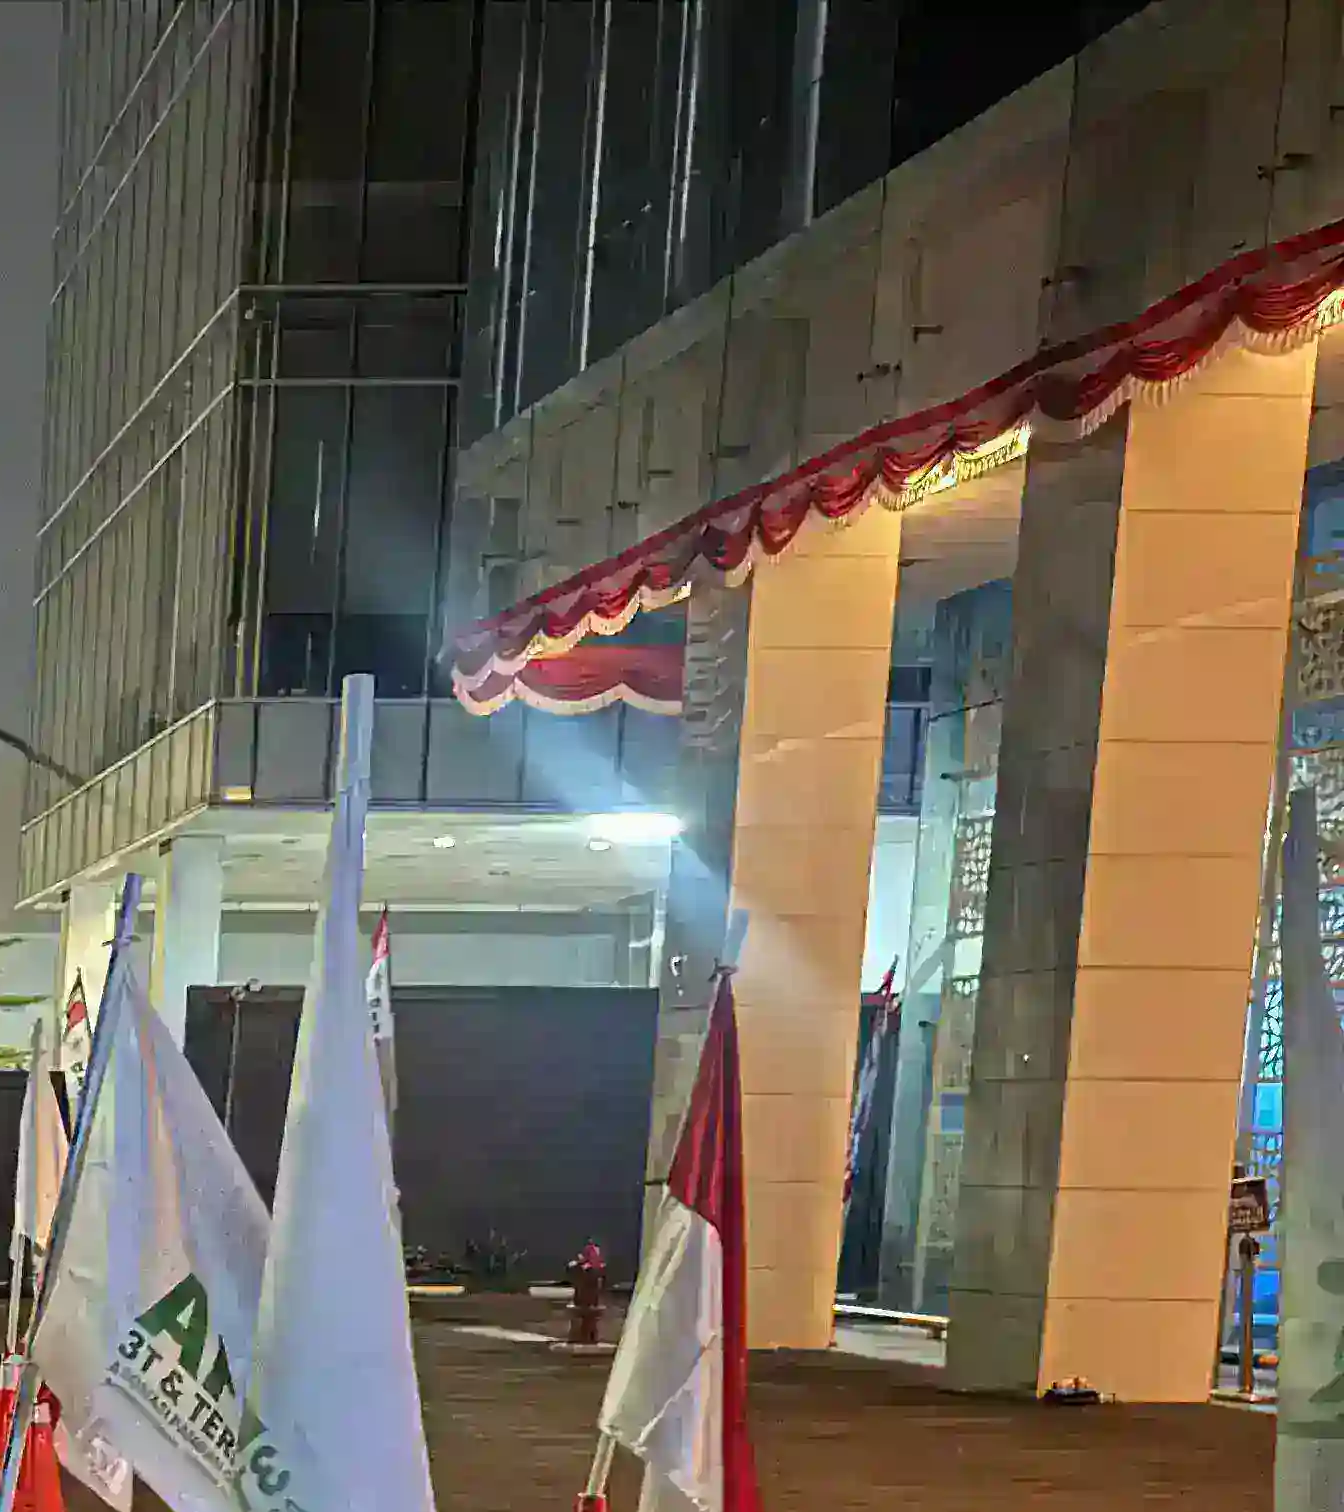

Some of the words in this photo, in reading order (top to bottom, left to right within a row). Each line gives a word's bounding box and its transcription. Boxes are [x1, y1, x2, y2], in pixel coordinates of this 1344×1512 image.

[118, 1329, 164, 1373] 3T
[160, 1368, 185, 1400] &
[188, 1392, 238, 1465] TER
